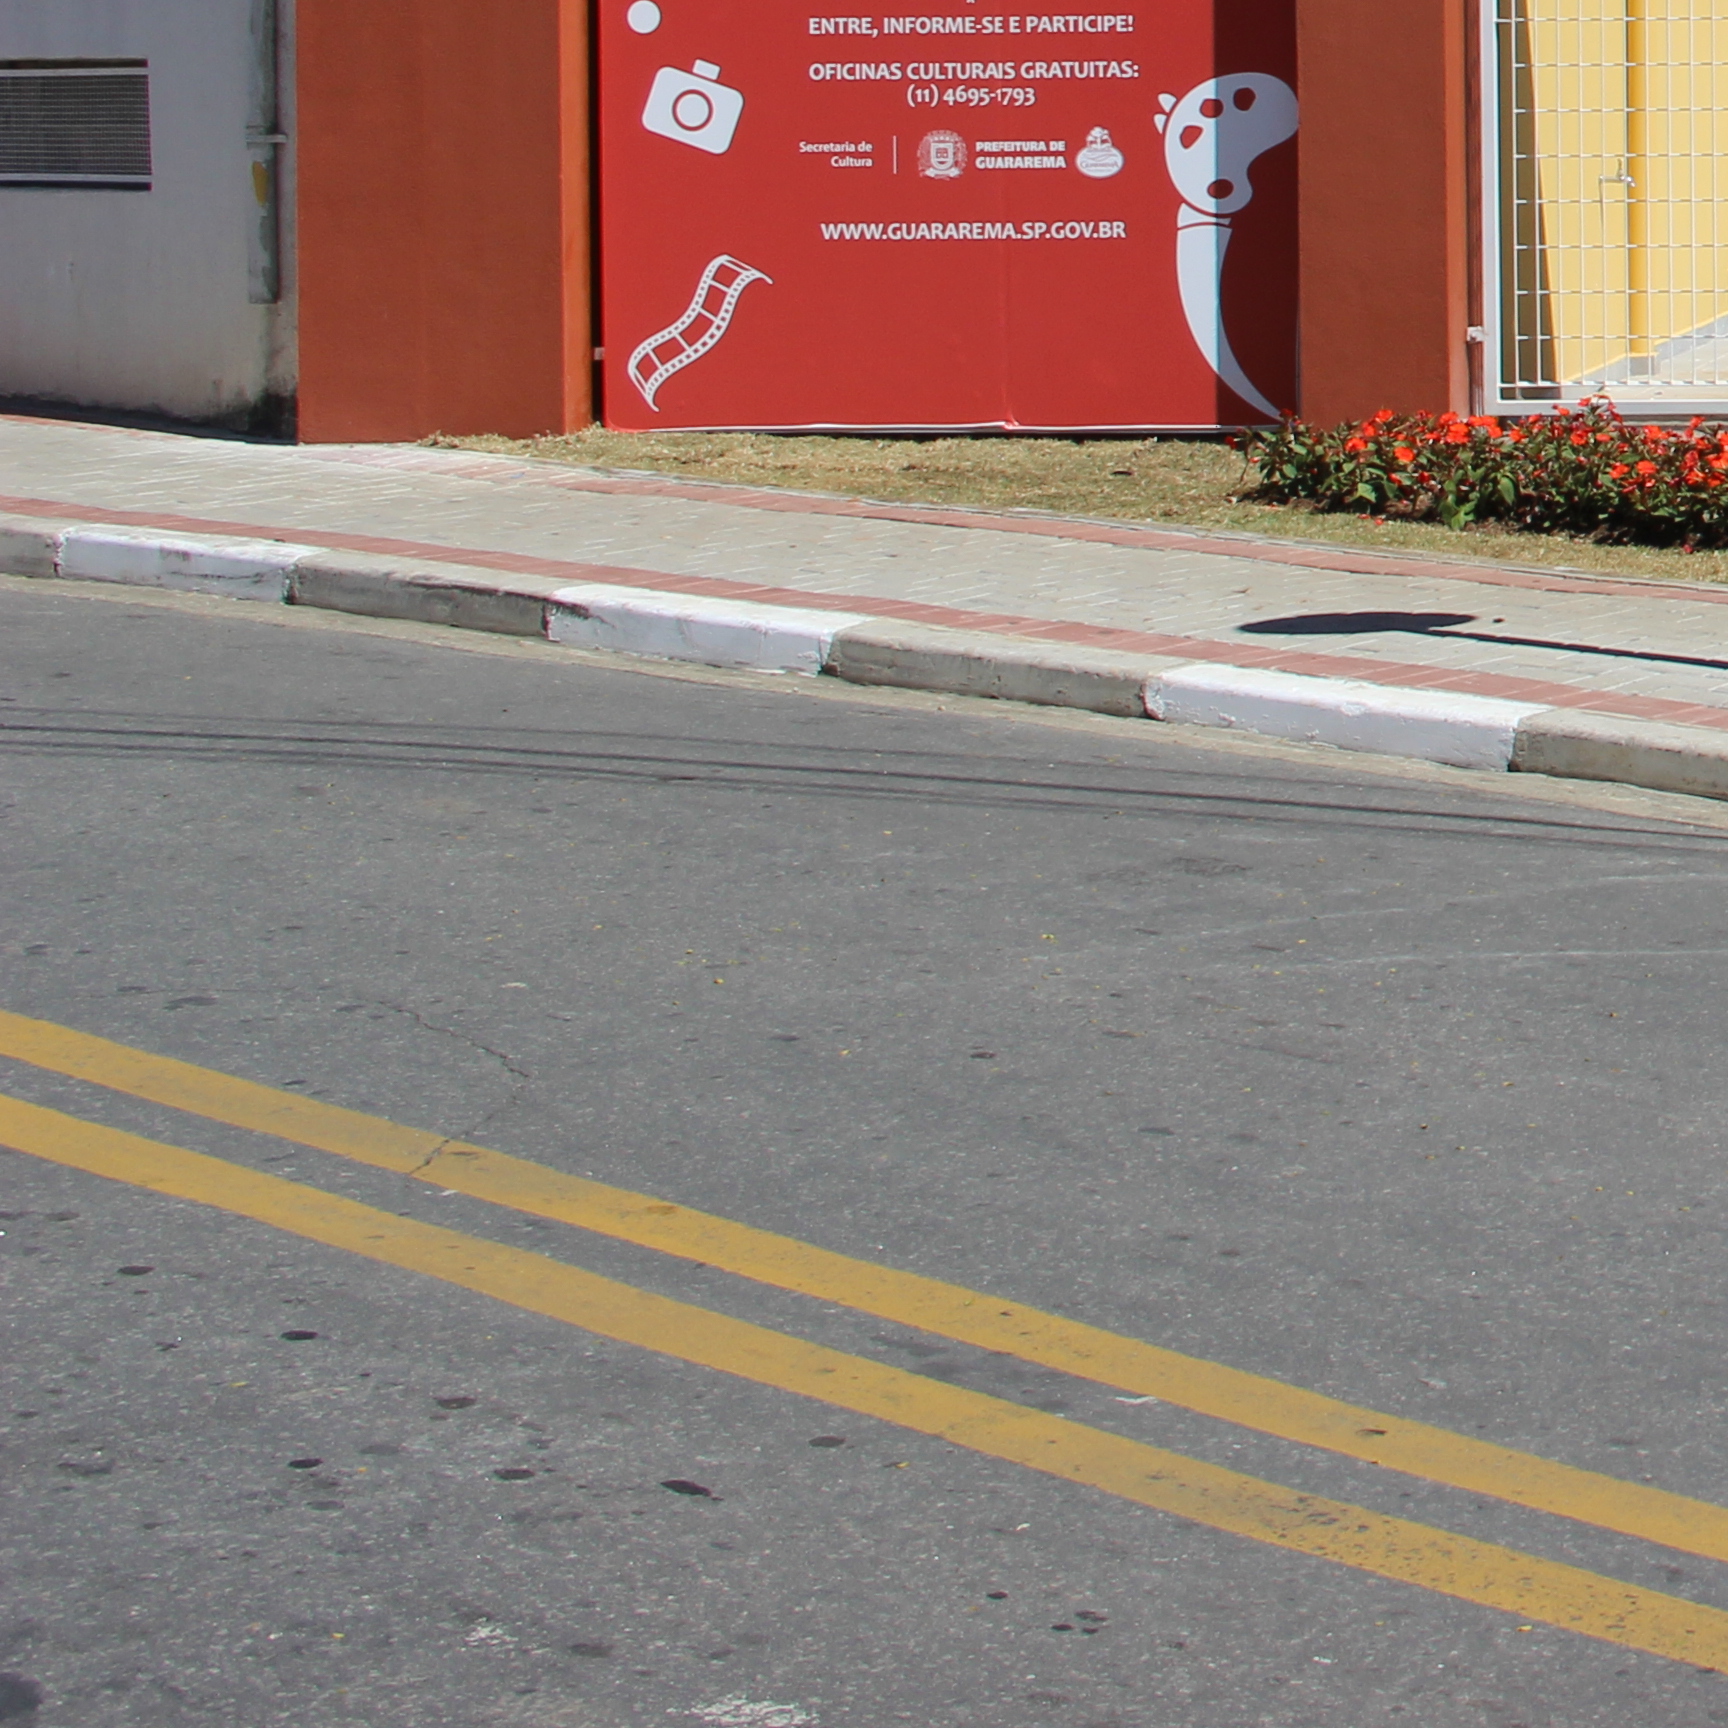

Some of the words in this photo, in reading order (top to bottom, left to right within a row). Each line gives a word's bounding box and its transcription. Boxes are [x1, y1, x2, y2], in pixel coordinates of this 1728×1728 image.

[808, 17, 879, 38] ENTRE,
[883, 16, 1005, 35] INFORME-SE
[1008, 16, 1021, 34] E
[1025, 14, 1134, 33] PARTICIPE!
[808, 62, 903, 81] OFICINAS
[906, 61, 1016, 80] CULTURAIS
[1019, 60, 1139, 79] GRATUITAS:
[906, 83, 939, 108] (11)
[942, 84, 1036, 107] 4695-1793
[798, 141, 854, 153] Secretaria
[857, 140, 873, 153] de
[975, 140, 1047, 153] PREFEITURA
[1049, 140, 1066, 152] DE
[830, 155, 873, 168] Cultura
[974, 155, 1067, 170] GUARAREMA
[820, 221, 1127, 241] WWW.GUARAREMA.SP.GOV.BR
